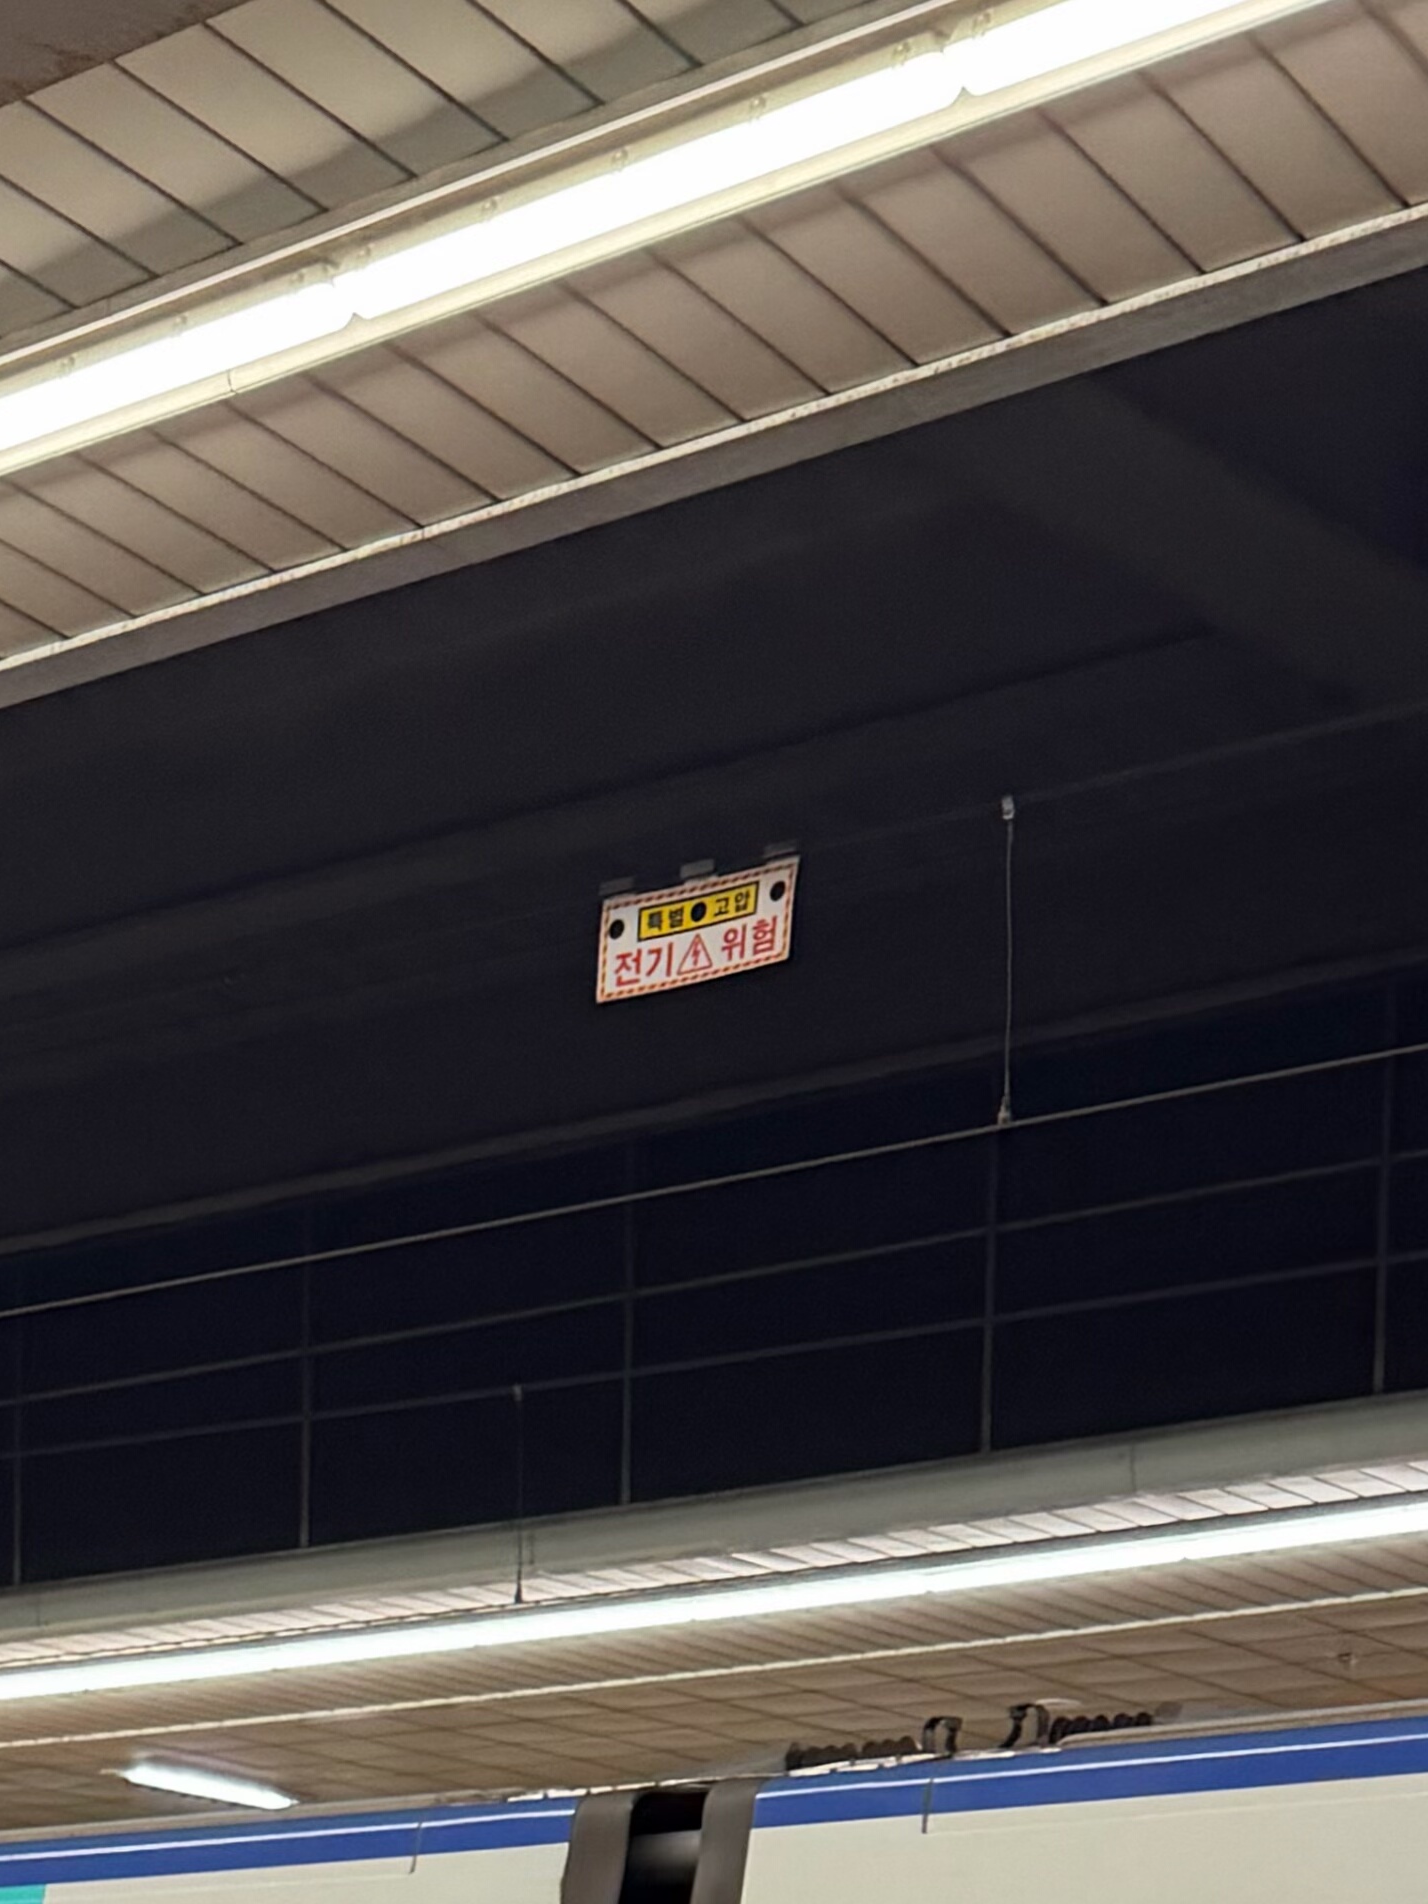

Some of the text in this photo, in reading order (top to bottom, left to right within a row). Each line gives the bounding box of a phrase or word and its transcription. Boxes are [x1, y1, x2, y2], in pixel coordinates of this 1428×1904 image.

[646, 891, 751, 931] 특별 고압
[613, 914, 778, 987] 전기 위험
